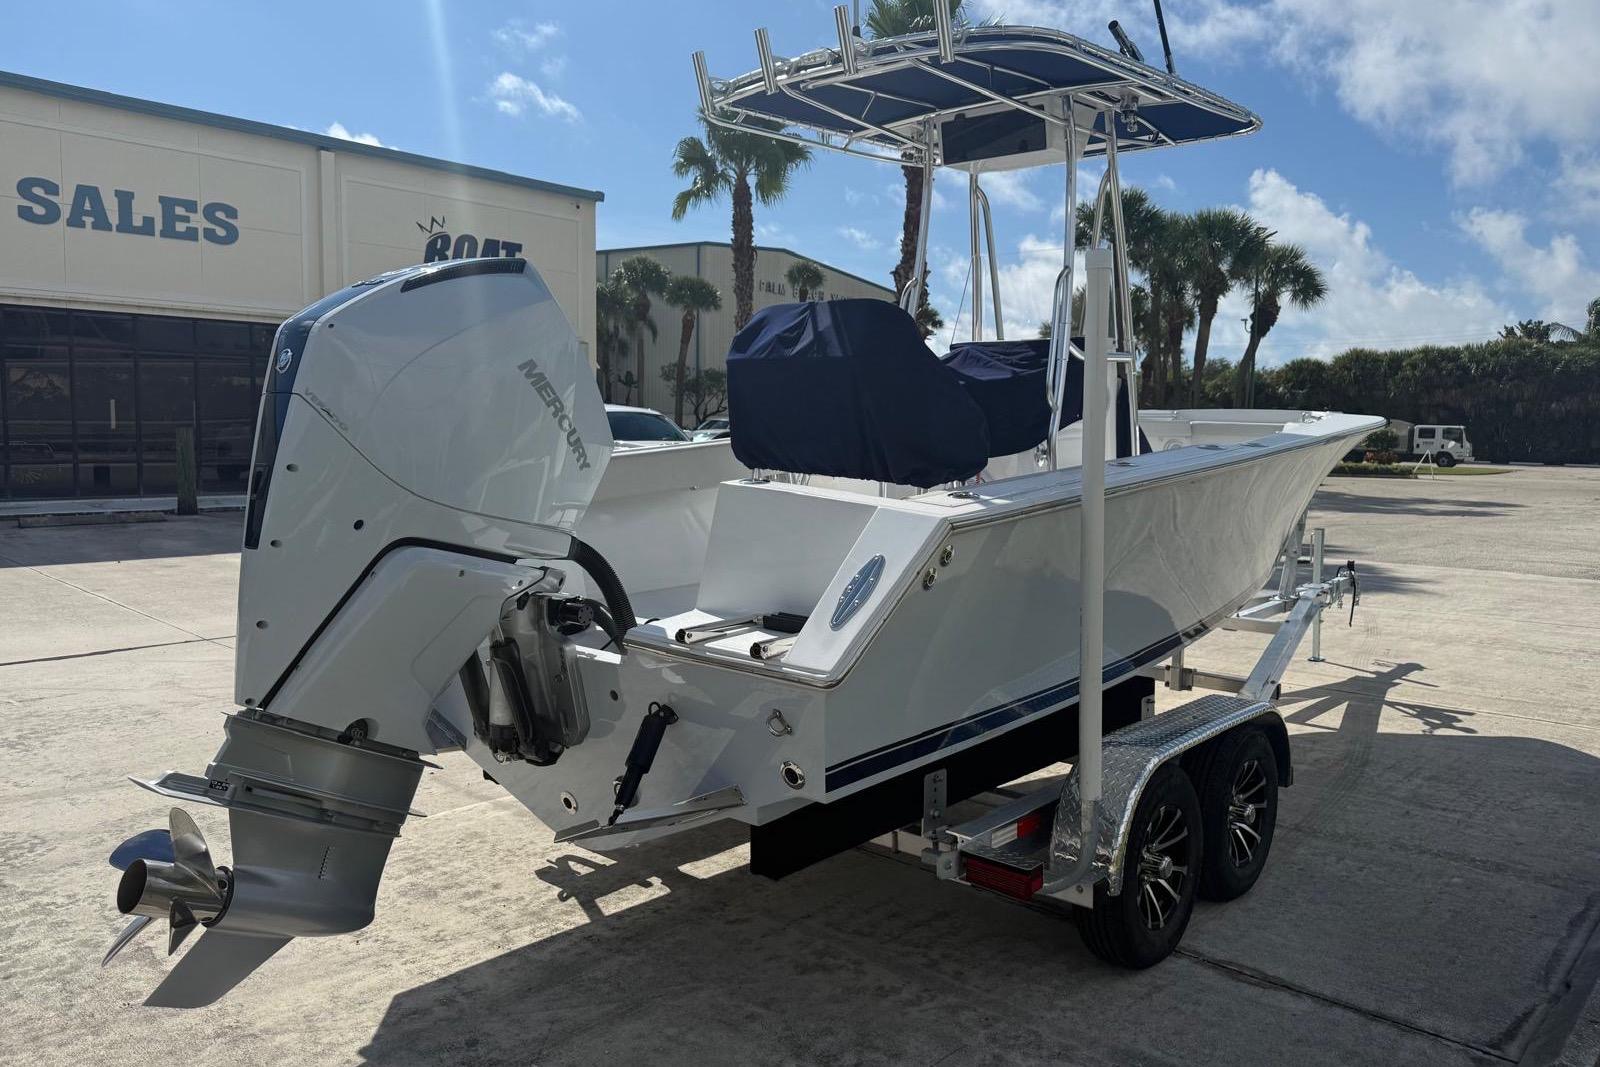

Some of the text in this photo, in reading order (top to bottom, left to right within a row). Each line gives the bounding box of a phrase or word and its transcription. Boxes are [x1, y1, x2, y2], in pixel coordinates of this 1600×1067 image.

[16, 177, 240, 246] SALES
[423, 232, 523, 263] BOAT
[759, 280, 786, 297] PALM
[792, 285, 825, 301] BACH
[517, 358, 591, 471] MERCURY
